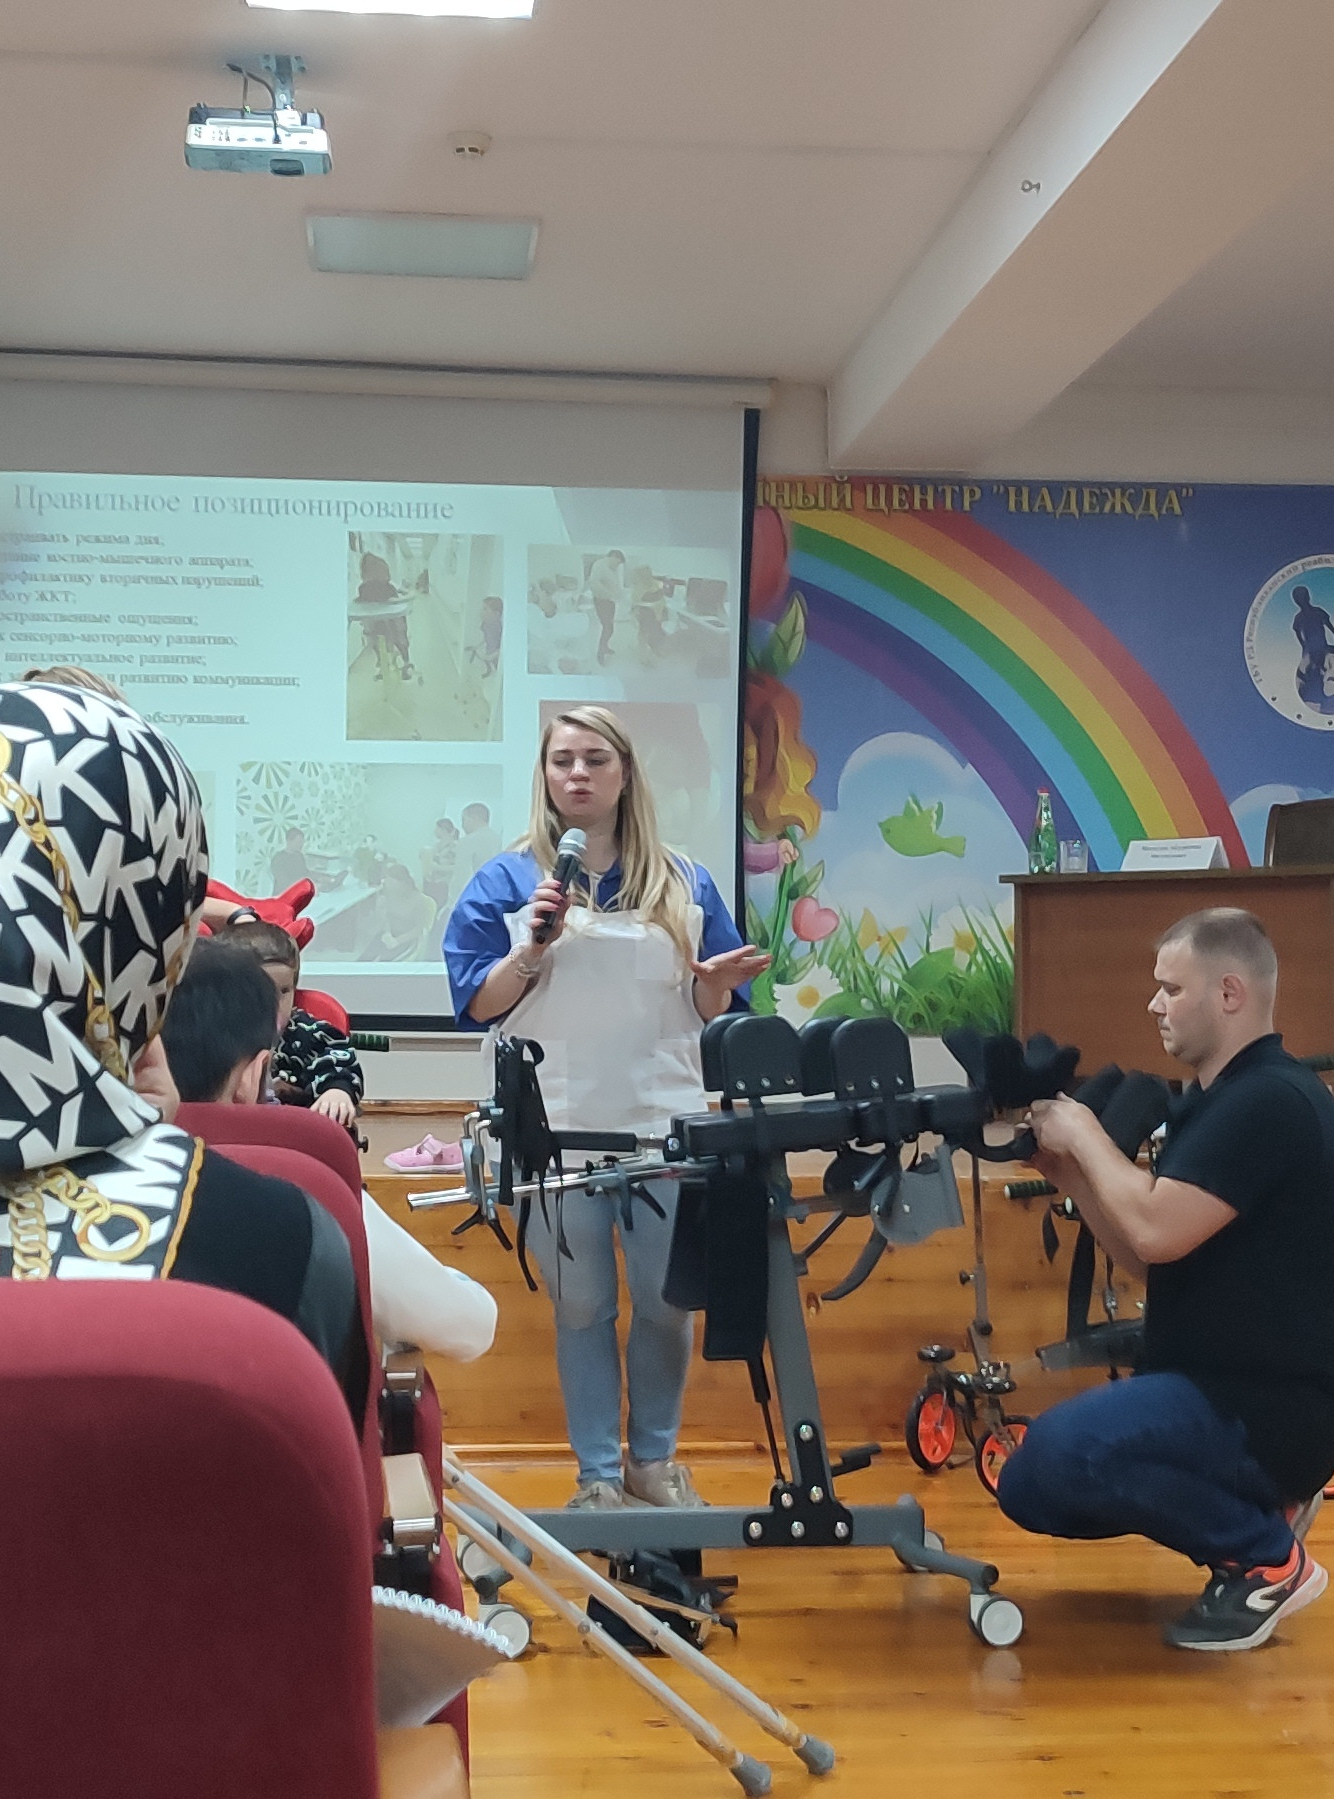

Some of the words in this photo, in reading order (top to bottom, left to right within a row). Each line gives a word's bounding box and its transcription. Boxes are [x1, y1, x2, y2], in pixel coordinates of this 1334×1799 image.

[14, 484, 181, 515] Правильное
[193, 493, 455, 525] позиционирование
[866, 483, 983, 516] ЦЕНТР
[993, 484, 1194, 521] "НАДЕЖДА"
